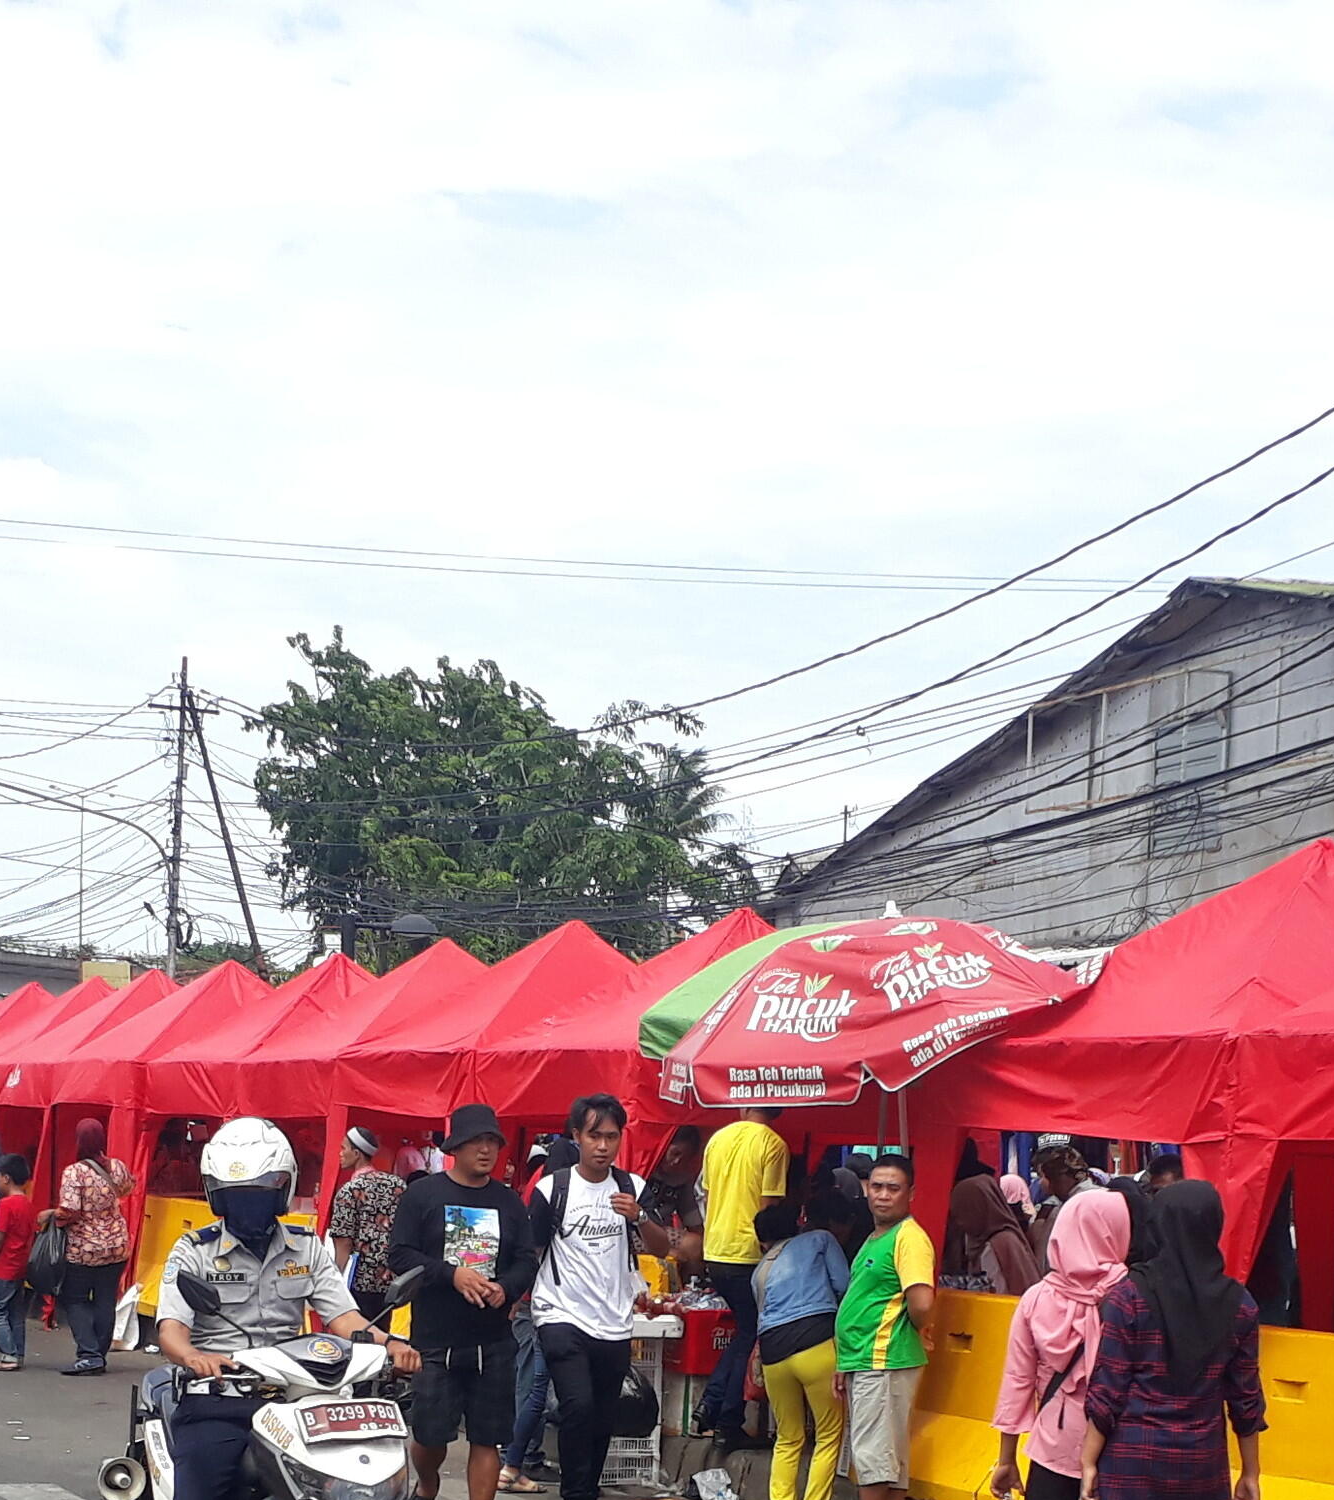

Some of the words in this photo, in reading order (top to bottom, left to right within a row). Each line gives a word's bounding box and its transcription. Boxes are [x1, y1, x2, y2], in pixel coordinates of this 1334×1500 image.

[754, 973, 801, 995] Teh
[907, 966, 993, 1004] HARUM
[764, 1016, 842, 1042] HARUM
[902, 1031, 934, 1053] Rasa
[934, 1018, 958, 1035] Teh
[958, 1007, 1010, 1025] Terbaik
[910, 1045, 935, 1067] ada
[932, 1035, 947, 1054] di
[729, 1067, 757, 1082] Rasa
[758, 1067, 779, 1081] Teh
[780, 1065, 824, 1080] Terbaik
[730, 1083, 752, 1099] ada
[754, 1083, 765, 1098] di
[212, 1273, 240, 1281] TROY
[303, 1411, 316, 1426] B
[326, 1405, 366, 1422] 3299
[261, 1408, 294, 1450] DISHUB
